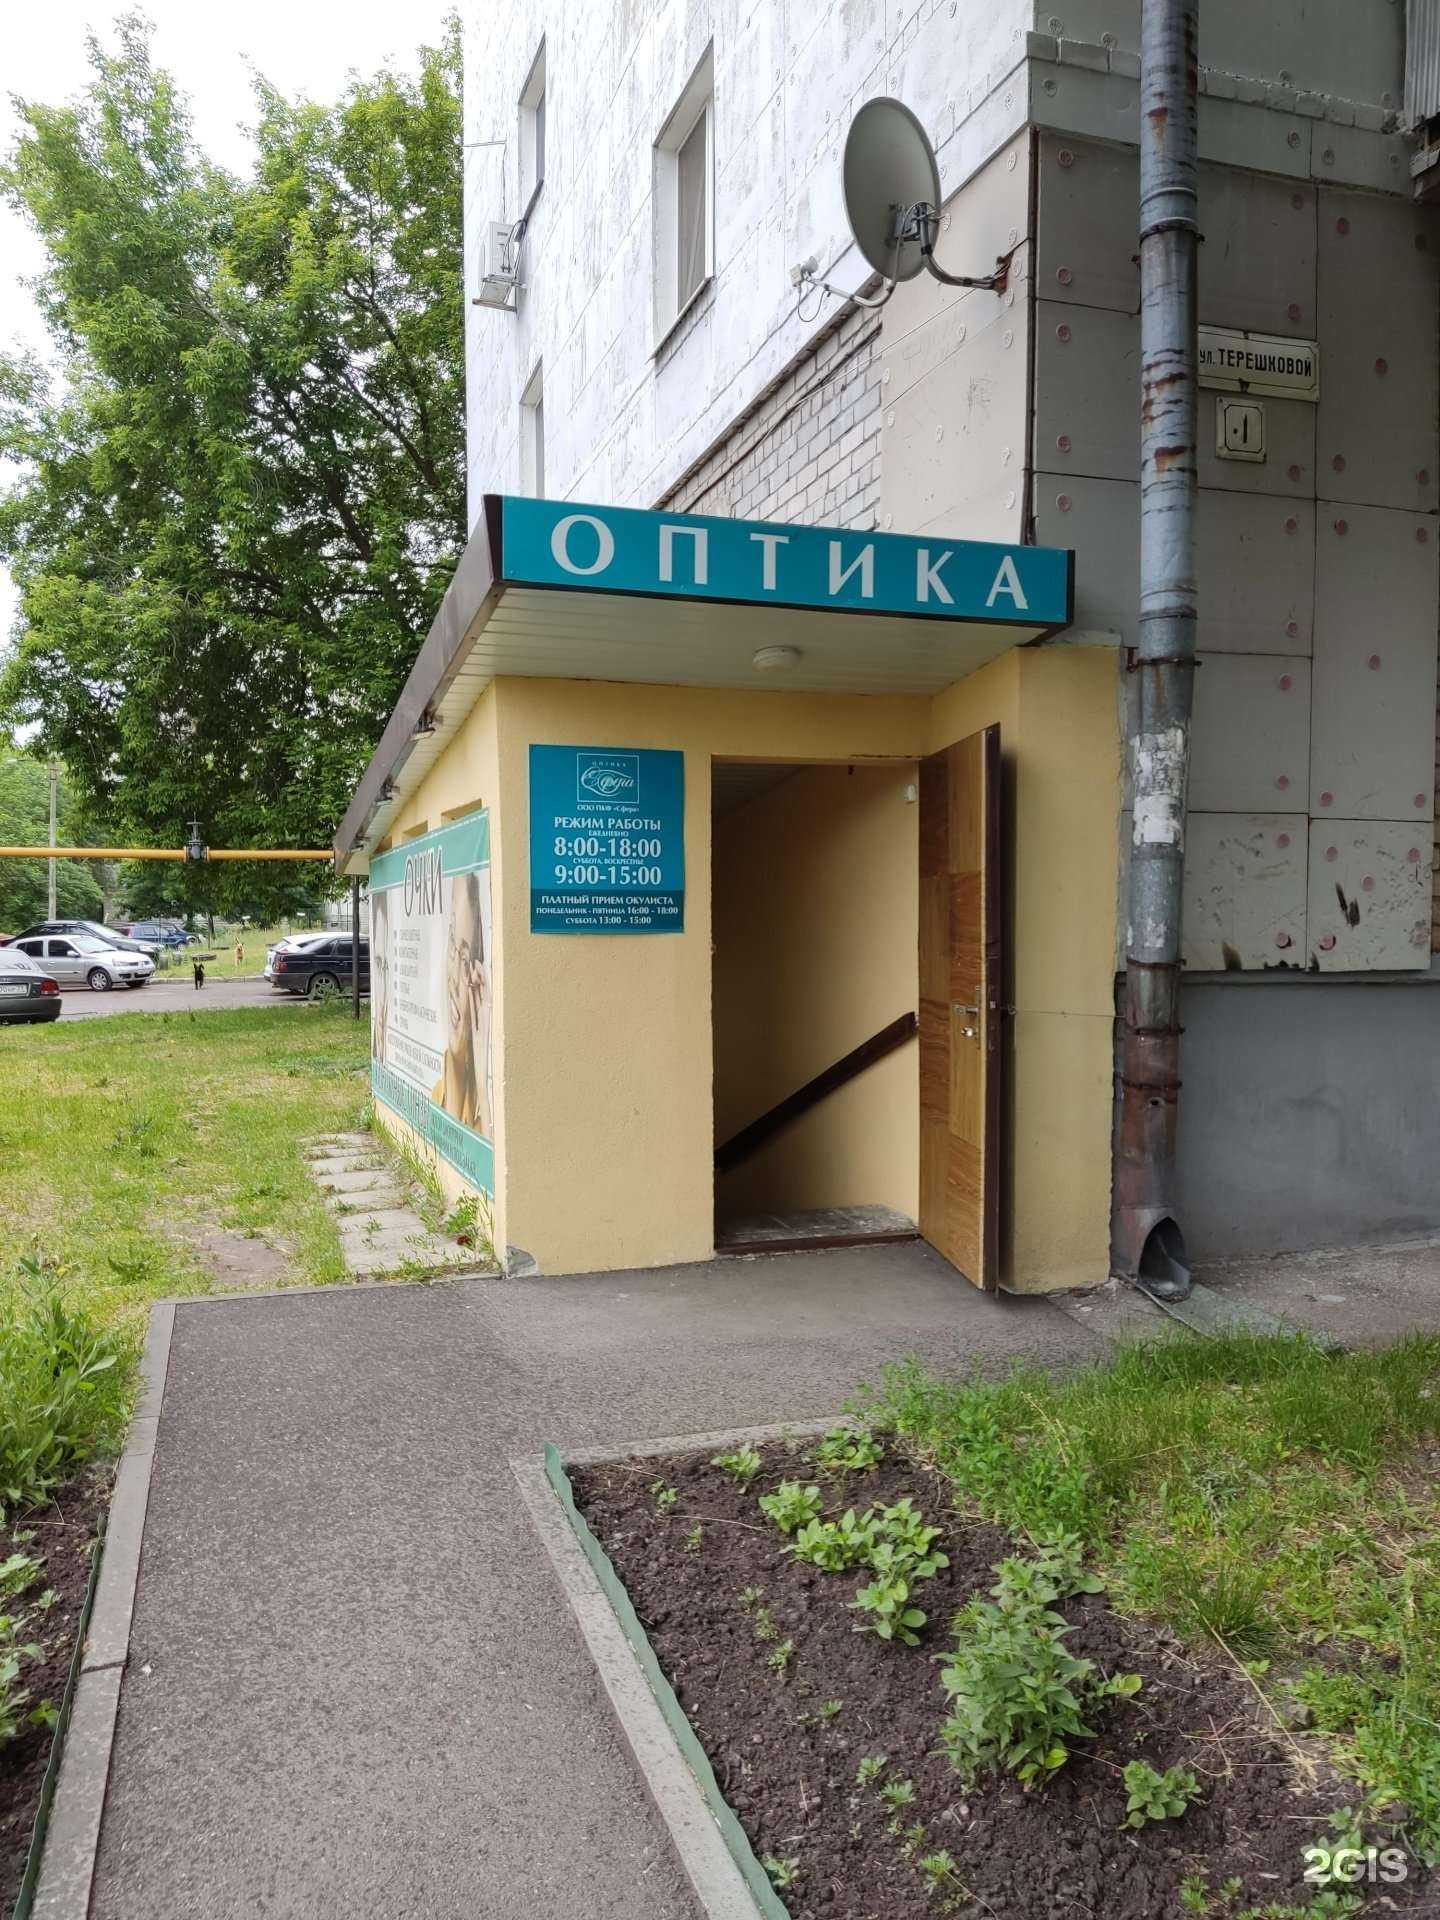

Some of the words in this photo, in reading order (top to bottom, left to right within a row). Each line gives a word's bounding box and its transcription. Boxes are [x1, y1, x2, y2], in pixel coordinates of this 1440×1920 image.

[1218, 348, 1312, 377] ТЕРЕШКОВОЙ
[550, 513, 1029, 610] ОПТИКА
[576, 804, 593, 812] ООО
[554, 816, 604, 830] РЕЖИМ
[607, 818, 661, 831] РАБОТЫ
[554, 836, 662, 858] 8:00-18:00
[404, 845, 443, 918] ОЧКИ
[554, 864, 662, 885] 9:00-15:00
[541, 894, 589, 905] ПЛАТНЫЙ
[591, 896, 624, 905] ПРИЕМ
[625, 896, 673, 905] ОКУЛИСТА
[627, 907, 650, 915] 16:00
[657, 907, 679, 915] 18:00
[565, 917, 598, 925] СУББОТА
[599, 916, 622, 925] 13:00
[629, 917, 652, 925] 15:00
